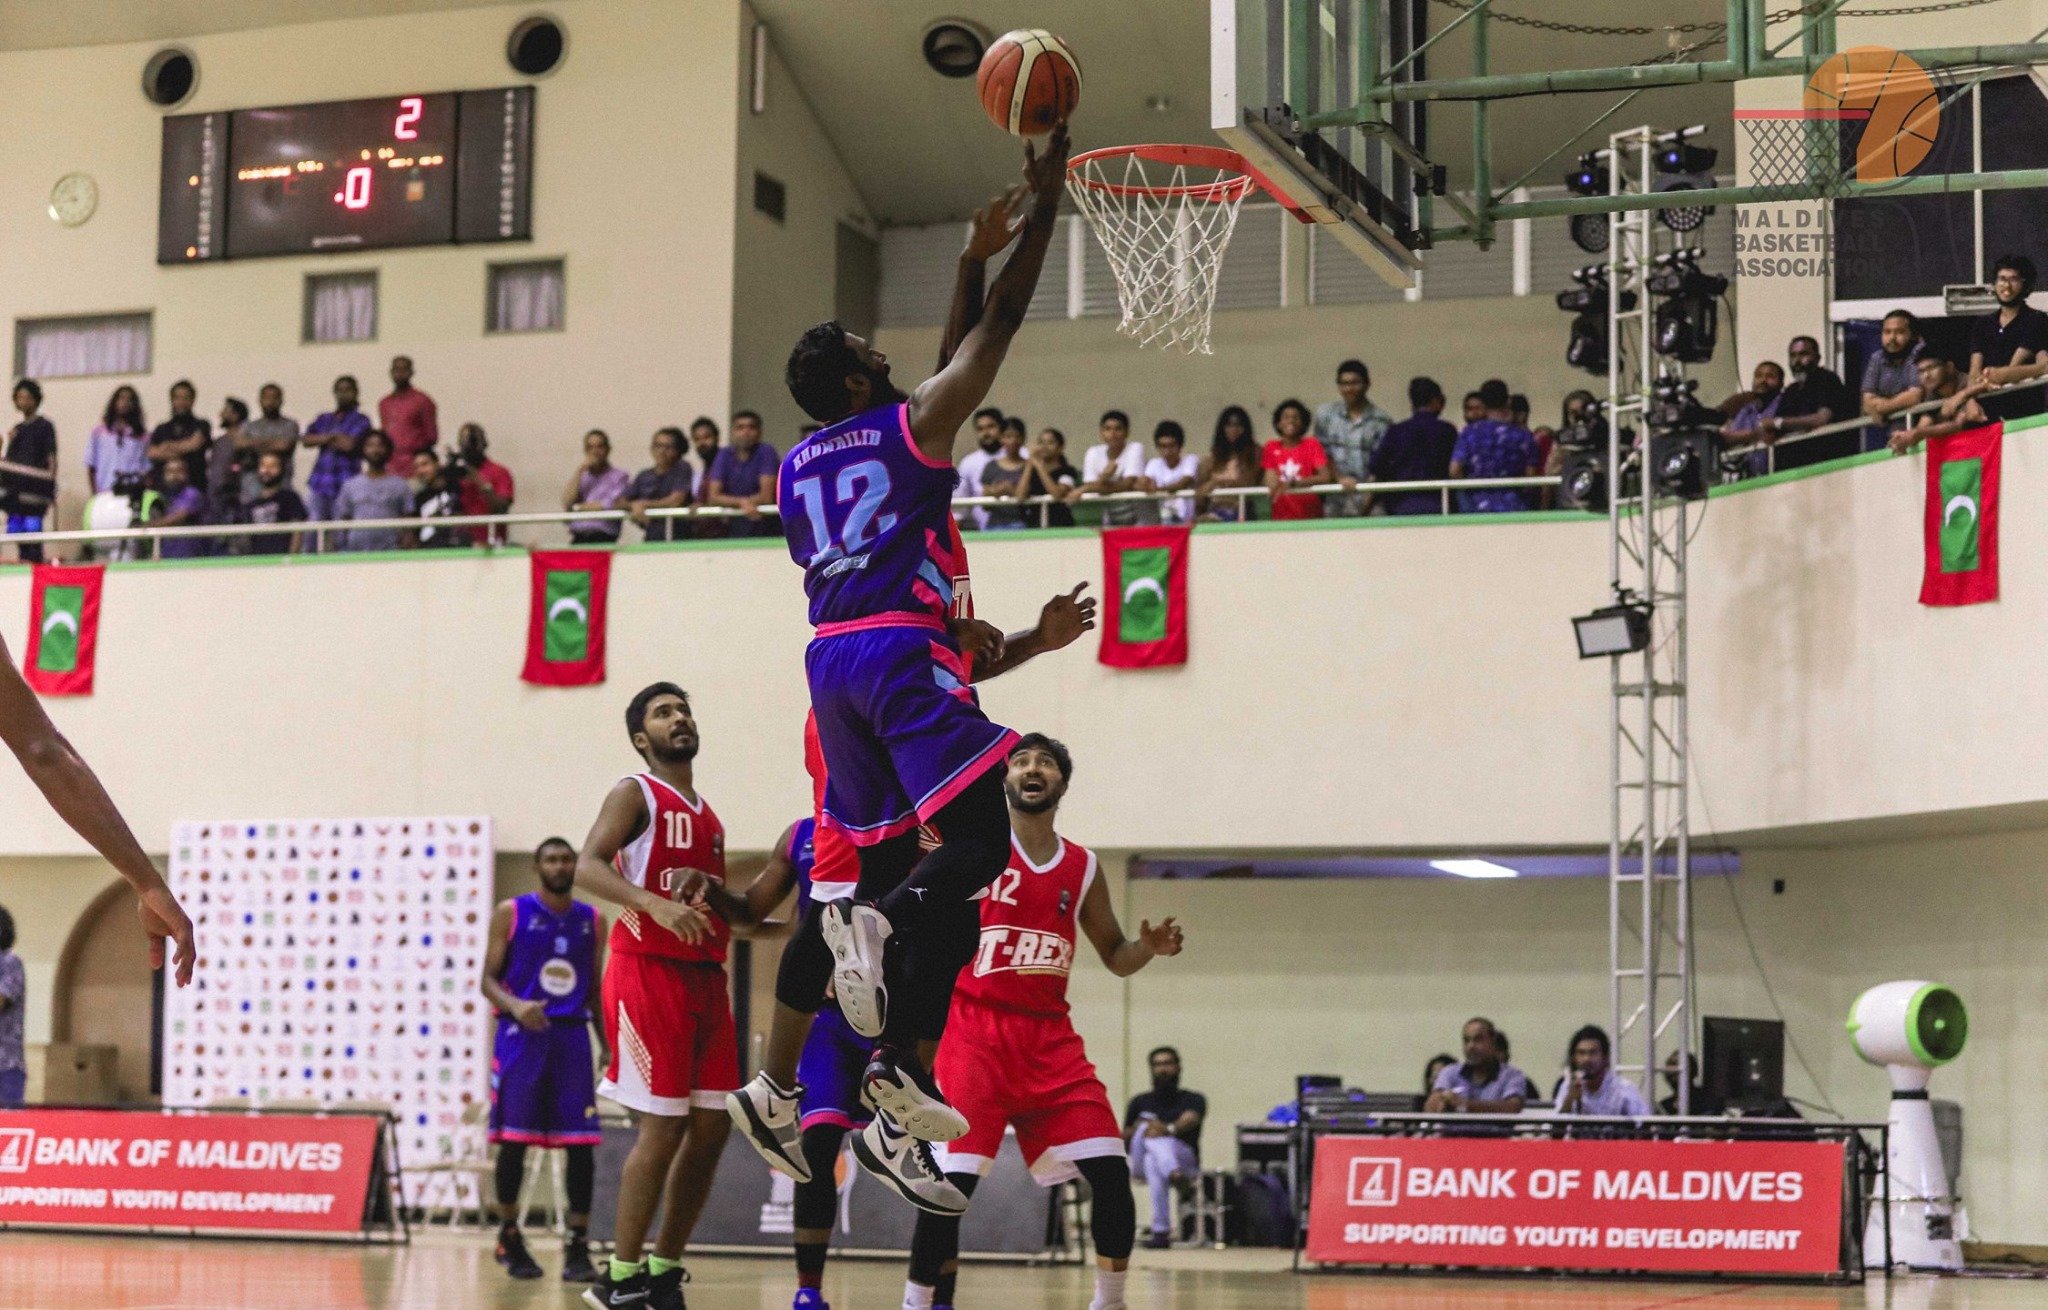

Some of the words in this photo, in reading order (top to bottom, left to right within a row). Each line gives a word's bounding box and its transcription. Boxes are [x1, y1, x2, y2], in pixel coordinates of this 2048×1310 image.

[394, 98, 423, 140] 2
[793, 460, 897, 565] 12
[663, 811, 693, 849] 10
[991, 867, 1021, 906] 12
[976, 928, 1072, 975] T-REX
[34, 1137, 122, 1167] BANK
[127, 1138, 172, 1168] OF
[176, 1139, 343, 1172] MALDIVES
[0, 1187, 107, 1208] UPPORTING
[111, 1189, 178, 1210] YOUTH
[180, 1190, 335, 1214] DEVELOPMENT
[1406, 1167, 1518, 1199] BANK
[1528, 1169, 1581, 1200] OF
[1593, 1169, 1803, 1203] MALDIVES
[1344, 1223, 1507, 1246] SUPPORTING
[1513, 1225, 1599, 1248] YOUTH
[1606, 1227, 1802, 1251] DEVELOPMENT
